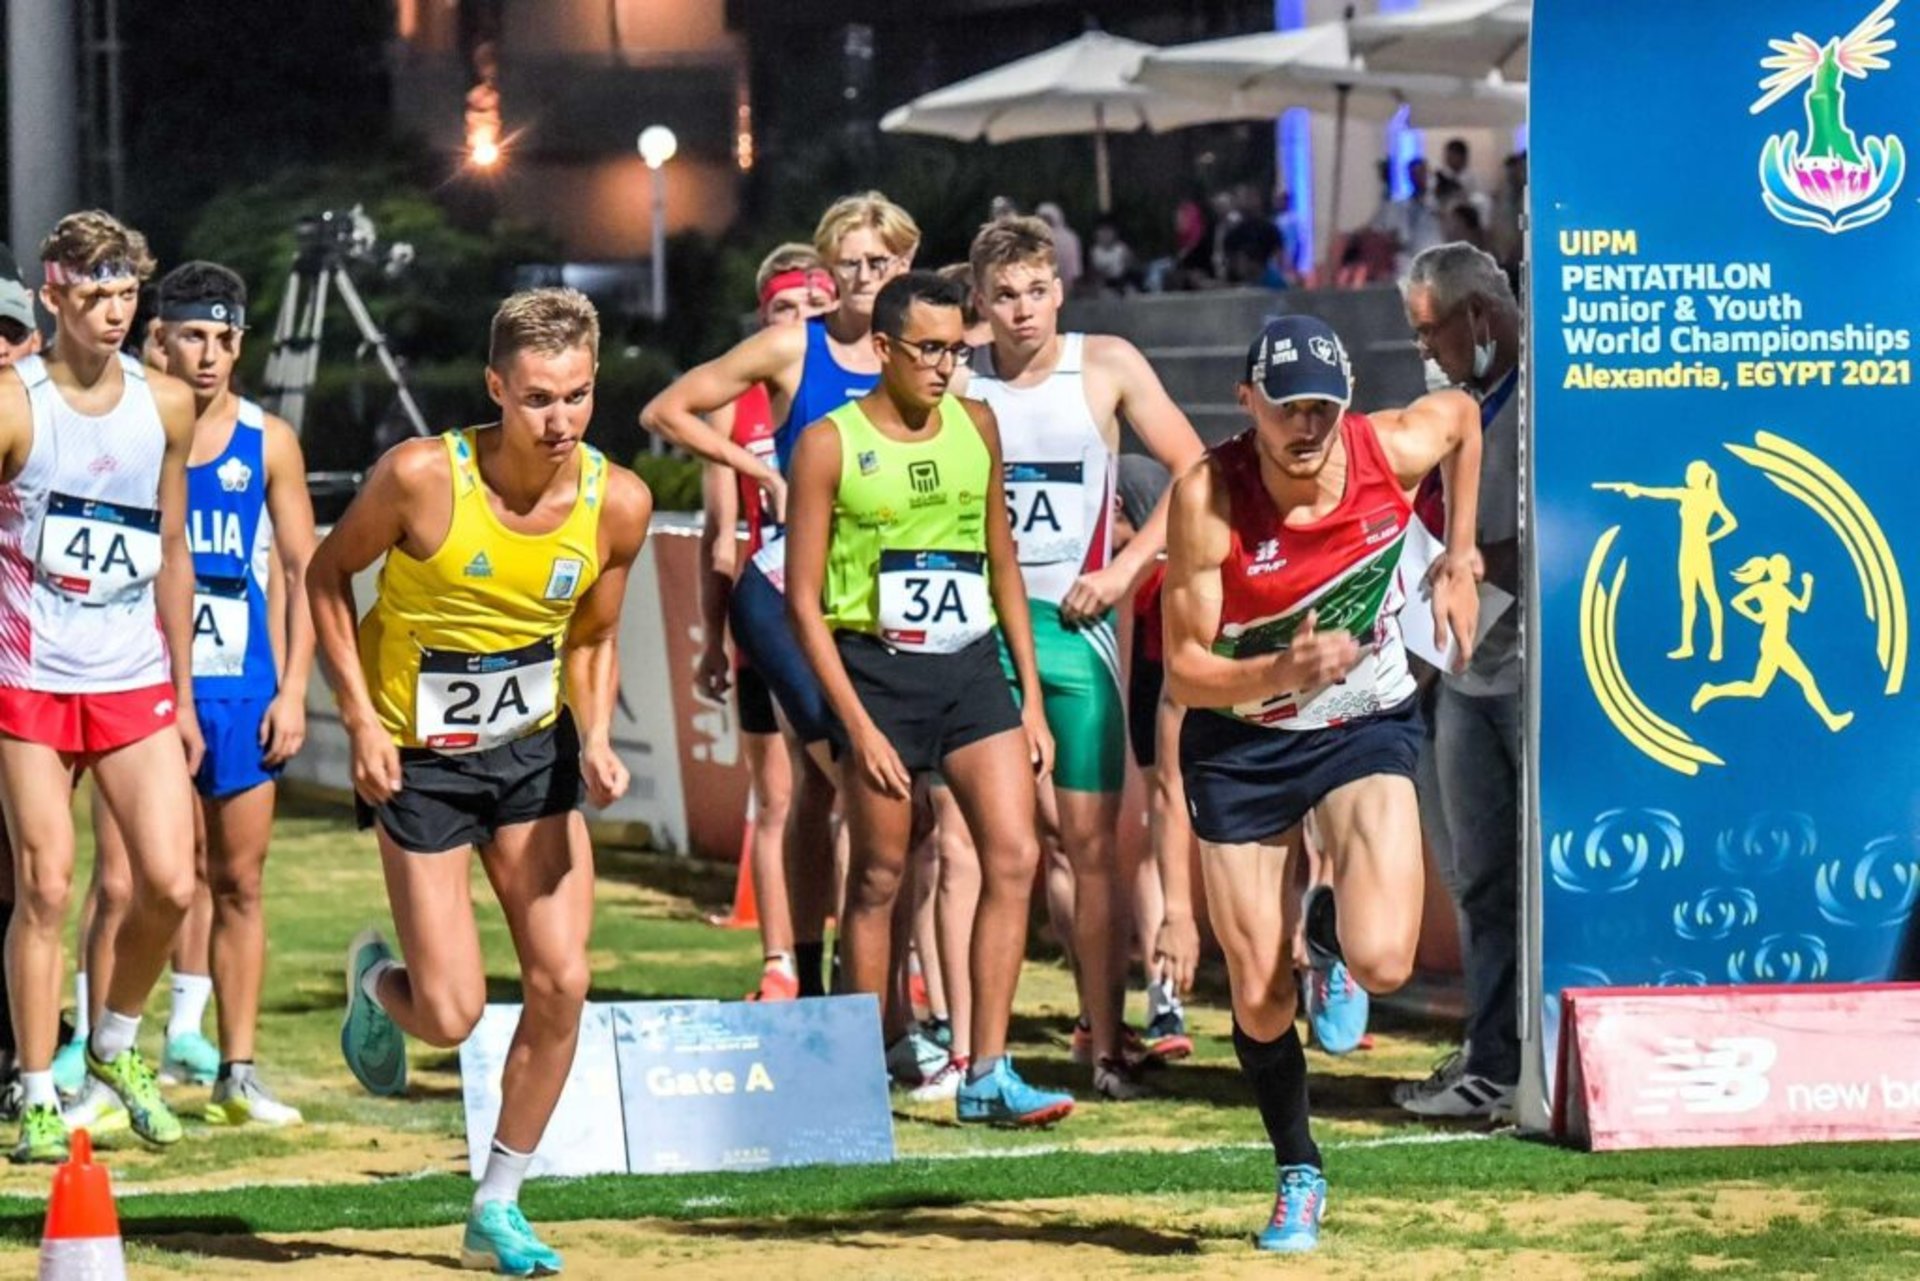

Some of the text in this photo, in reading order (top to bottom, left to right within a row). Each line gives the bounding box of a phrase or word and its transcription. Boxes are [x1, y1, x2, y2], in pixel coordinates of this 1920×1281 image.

[1559, 230, 1638, 255] UIPM
[1561, 263, 1772, 291] PENTATHLON
[1562, 294, 1802, 323] Junior & Youth
[1562, 324, 1911, 357] World Championships
[1562, 360, 1911, 391] Alexandria, EGYPT 2021
[64, 526, 138, 578] 4A
[902, 578, 968, 623] 3A
[443, 675, 530, 725] 2A
[646, 1062, 775, 1096] Gate A
[1787, 1081, 1871, 1112] new
